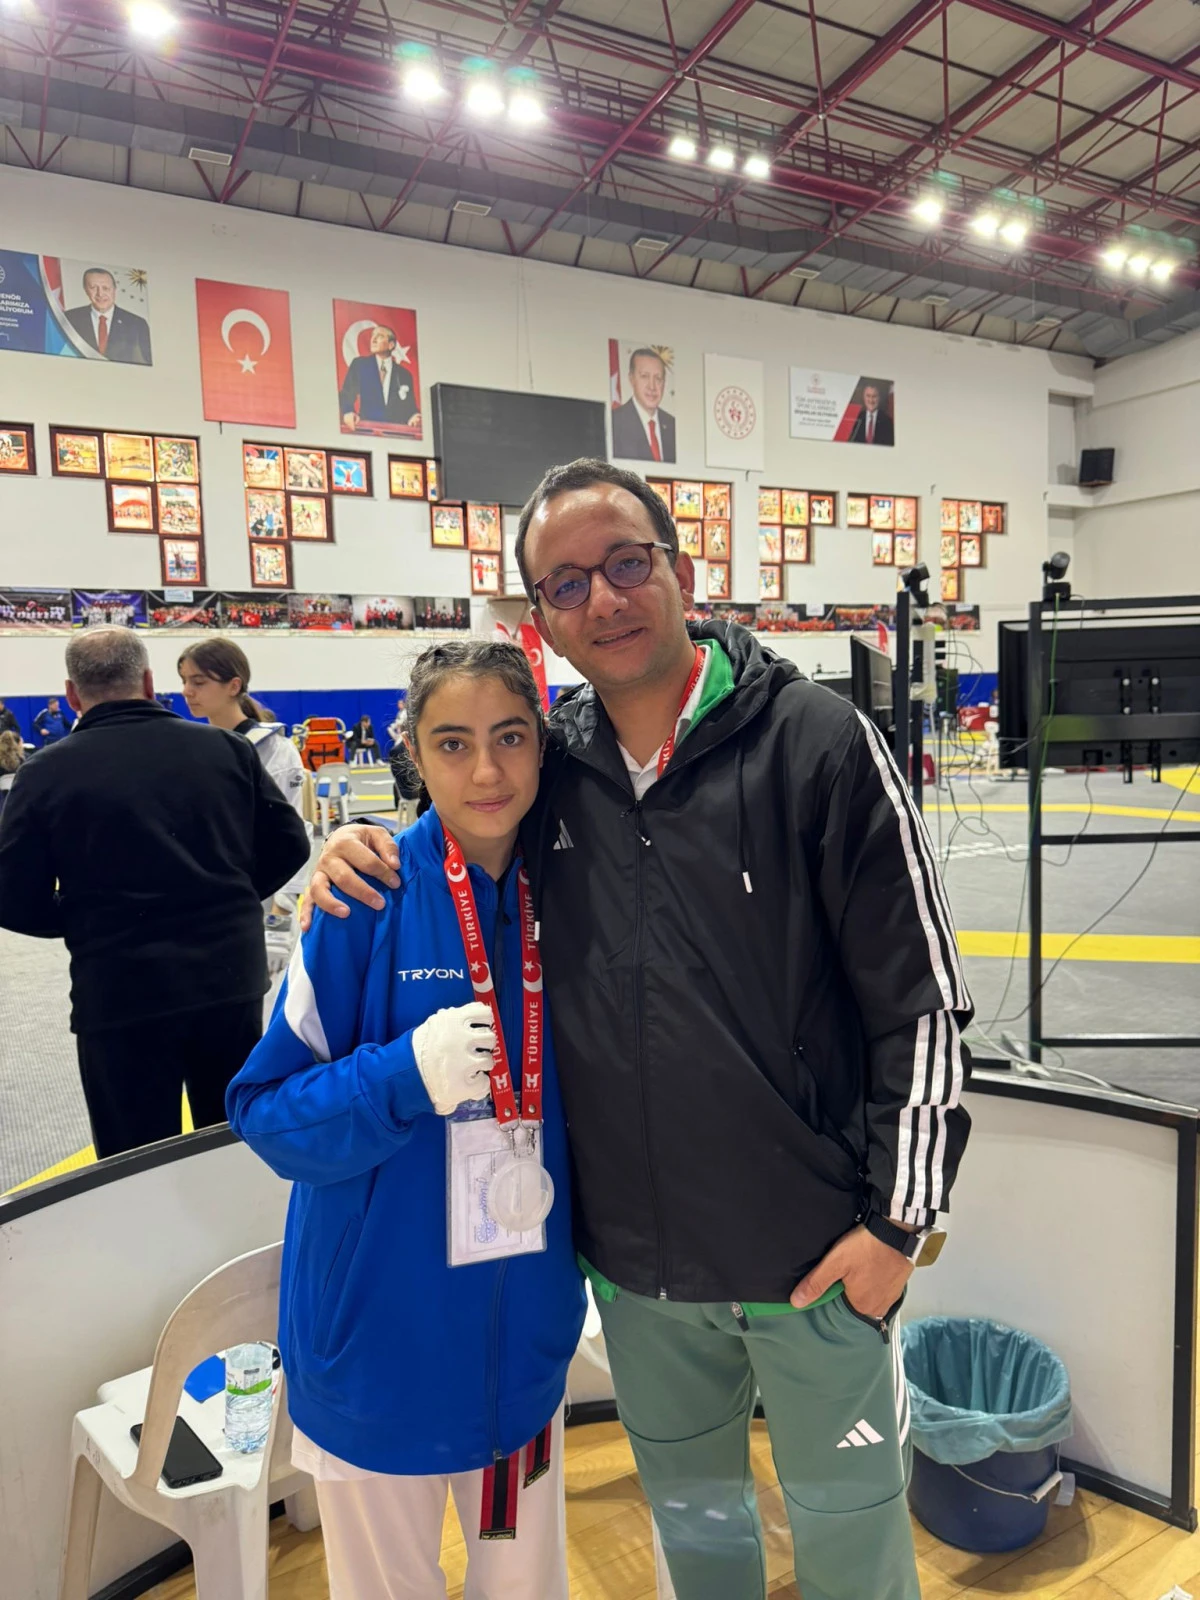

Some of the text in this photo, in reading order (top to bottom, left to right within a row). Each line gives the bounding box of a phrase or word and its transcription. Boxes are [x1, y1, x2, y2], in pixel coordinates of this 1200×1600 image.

[457, 889, 480, 951] TÜRKİYE
[397, 967, 465, 982] TRYON
[527, 1001, 539, 1064] TÜRKİYE
